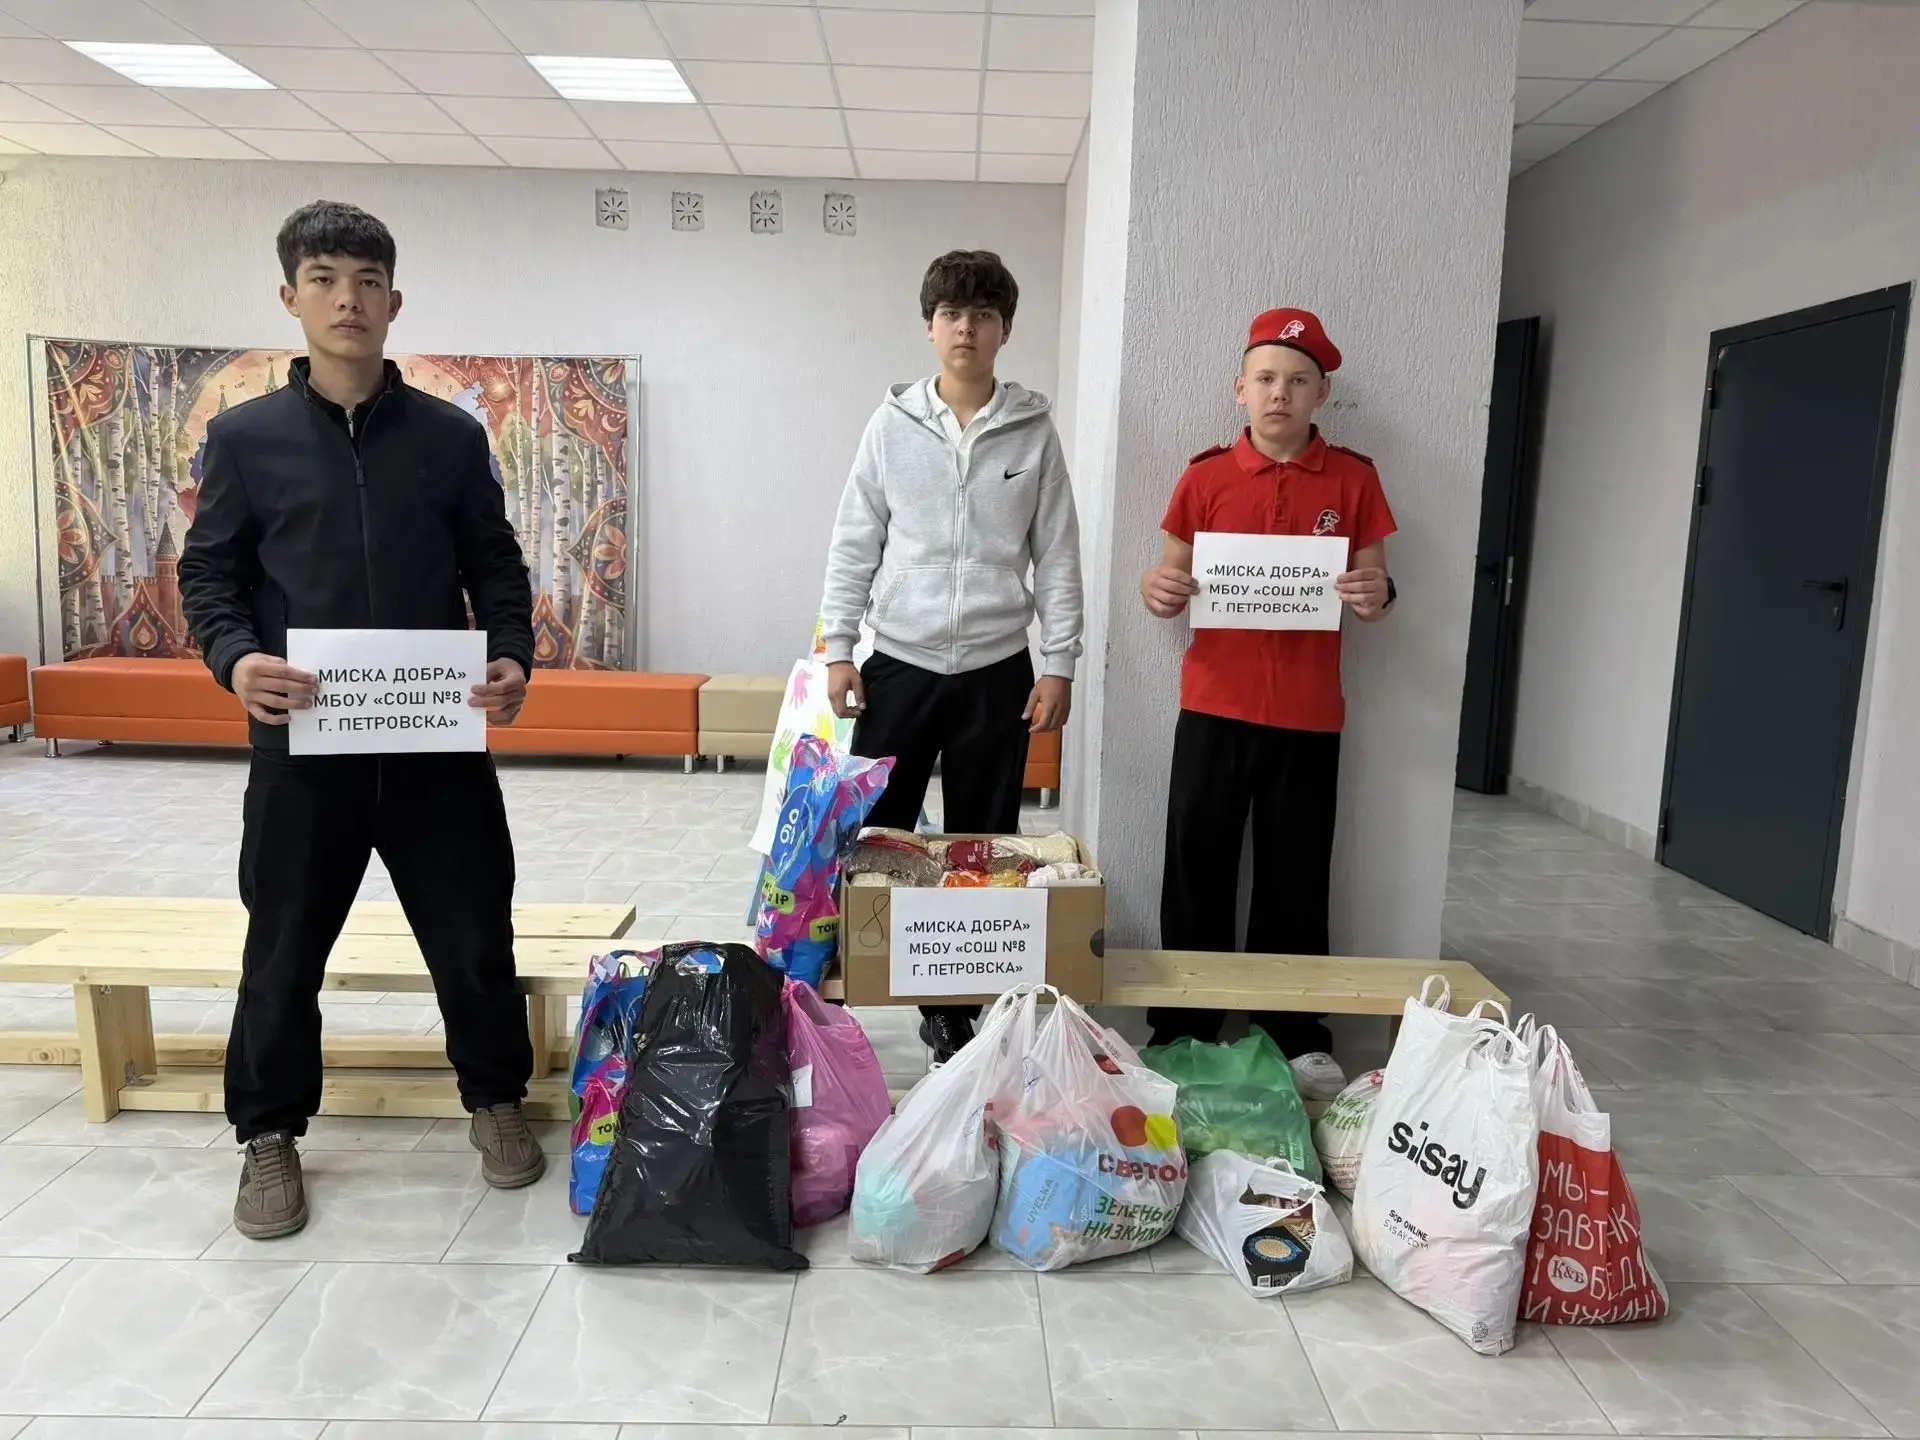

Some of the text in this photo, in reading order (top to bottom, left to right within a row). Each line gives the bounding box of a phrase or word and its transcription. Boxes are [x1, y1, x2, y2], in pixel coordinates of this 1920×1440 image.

[1206, 564, 1330, 579] «МИСКА ДОБРА»
[1209, 584, 1324, 597] МБОУ «СОШ №8
[1211, 602, 1320, 614] Г. ПЕТРОВСКА»
[316, 667, 467, 684] МИСКА ДОБРА»
[313, 690, 462, 708] МБОУ «СОШ №8
[318, 714, 459, 732] Г. ПЕТРОВСКА»
[904, 919, 1031, 935] «МИСКА ДОБРА»
[909, 939, 1026, 955] МБОУ «СОШ №8
[912, 961, 1023, 977] Г. ПЕТРОВСКА»
